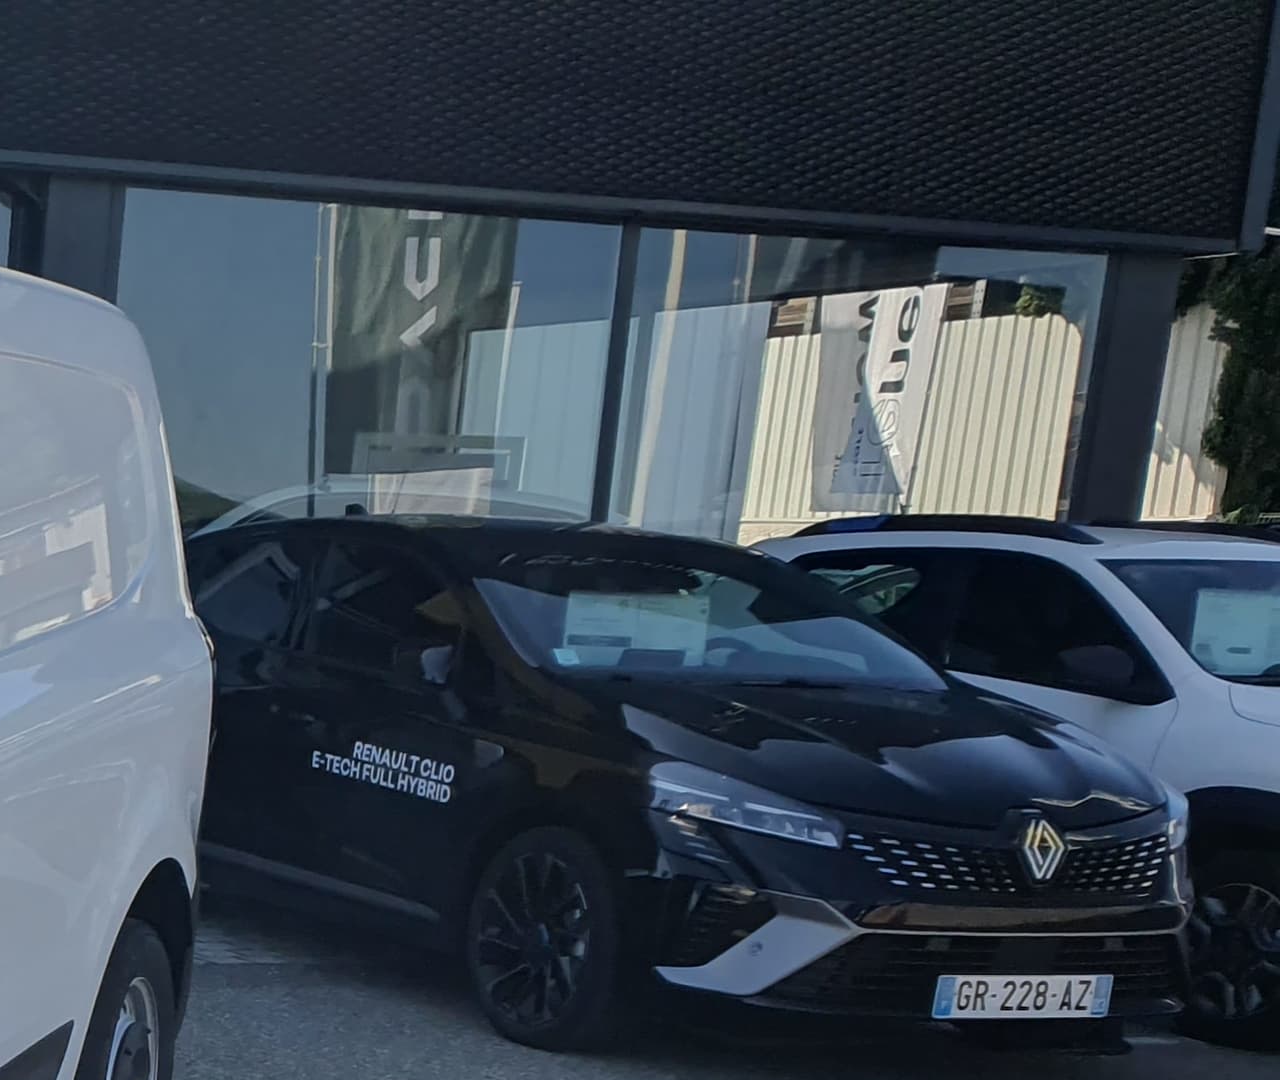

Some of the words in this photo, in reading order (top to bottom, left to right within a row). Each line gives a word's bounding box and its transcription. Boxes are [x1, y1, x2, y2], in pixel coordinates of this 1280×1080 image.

[311, 749, 360, 779] E-TECH
[362, 763, 395, 788] FULL
[397, 772, 452, 803] HYBRID
[353, 740, 421, 773] RENAULT
[420, 758, 456, 782] CLIO
[956, 979, 1092, 1011] GR-228-AZ
